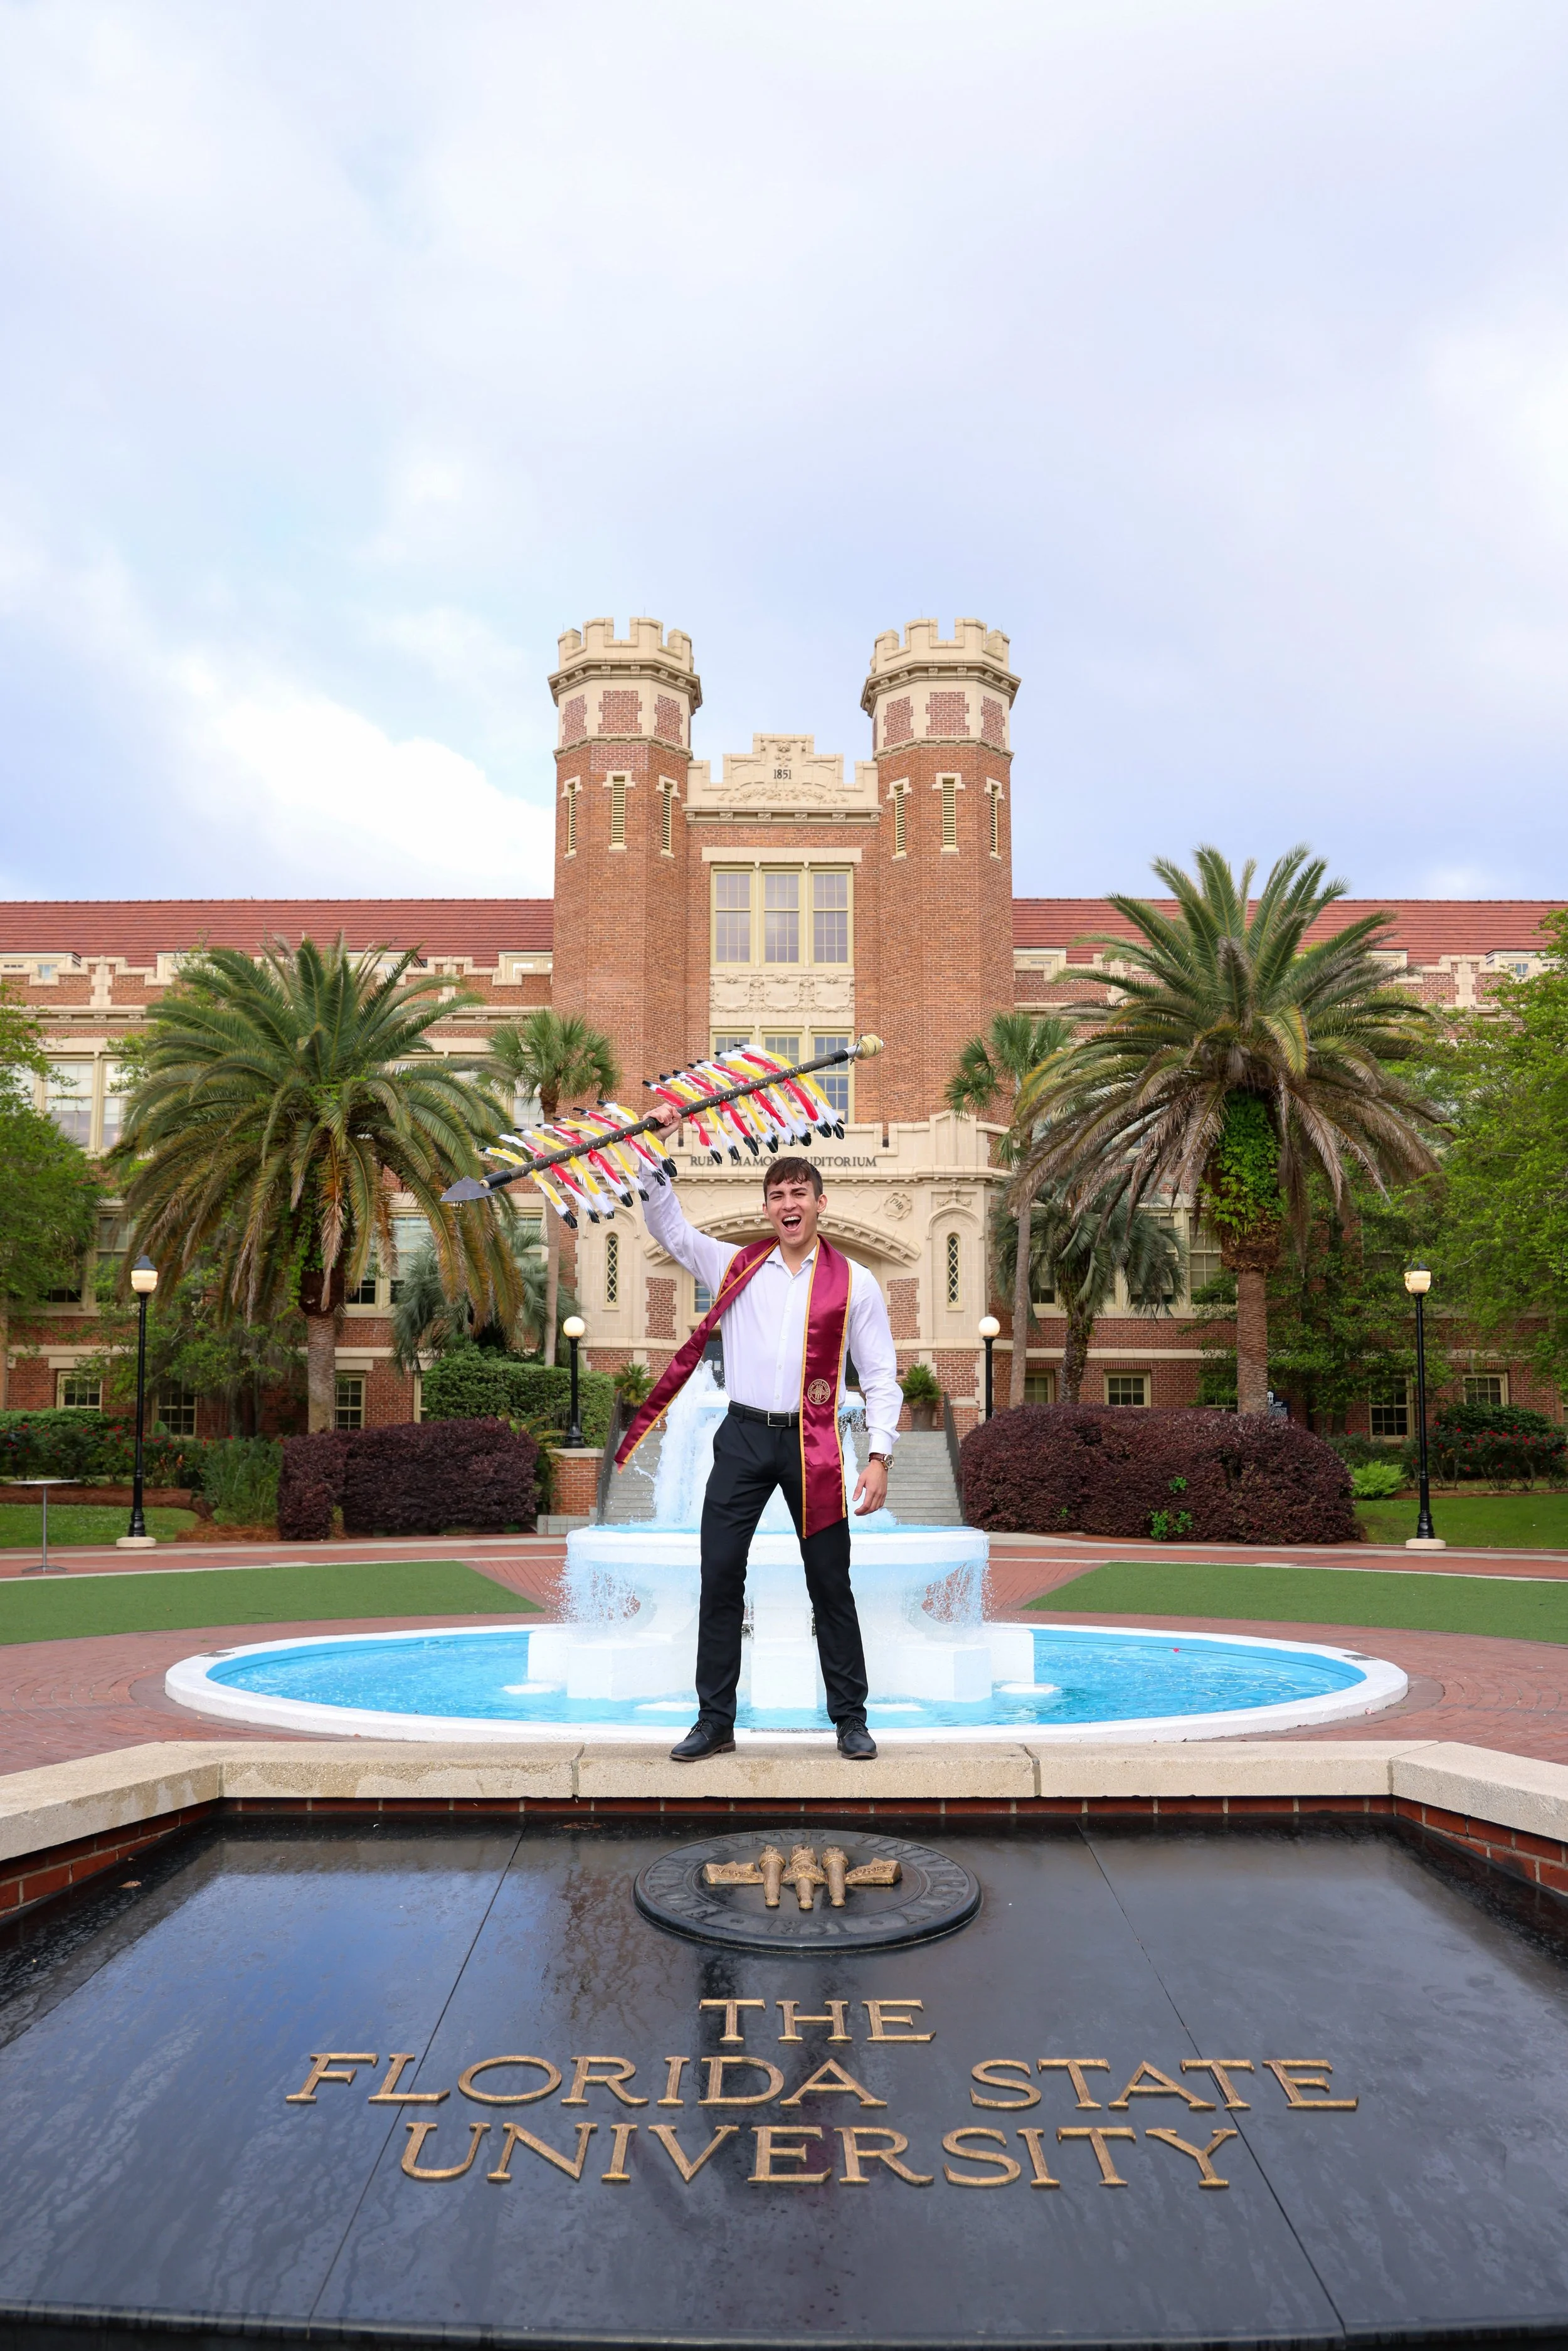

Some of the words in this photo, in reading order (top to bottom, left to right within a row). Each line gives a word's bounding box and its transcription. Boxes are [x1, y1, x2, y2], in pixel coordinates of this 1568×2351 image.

[773, 769, 792, 779] 1851
[803, 1156, 877, 1167] UDITORIUM
[889, 1197, 904, 1210] 1910
[702, 1830, 826, 1852] STATE
[766, 1918, 853, 1936] 1851
[699, 1998, 936, 2045] THE
[285, 2052, 888, 2108] FLORIDA
[969, 2058, 1360, 2110] STATE
[400, 2122, 1239, 2187] UNIVERSITY
